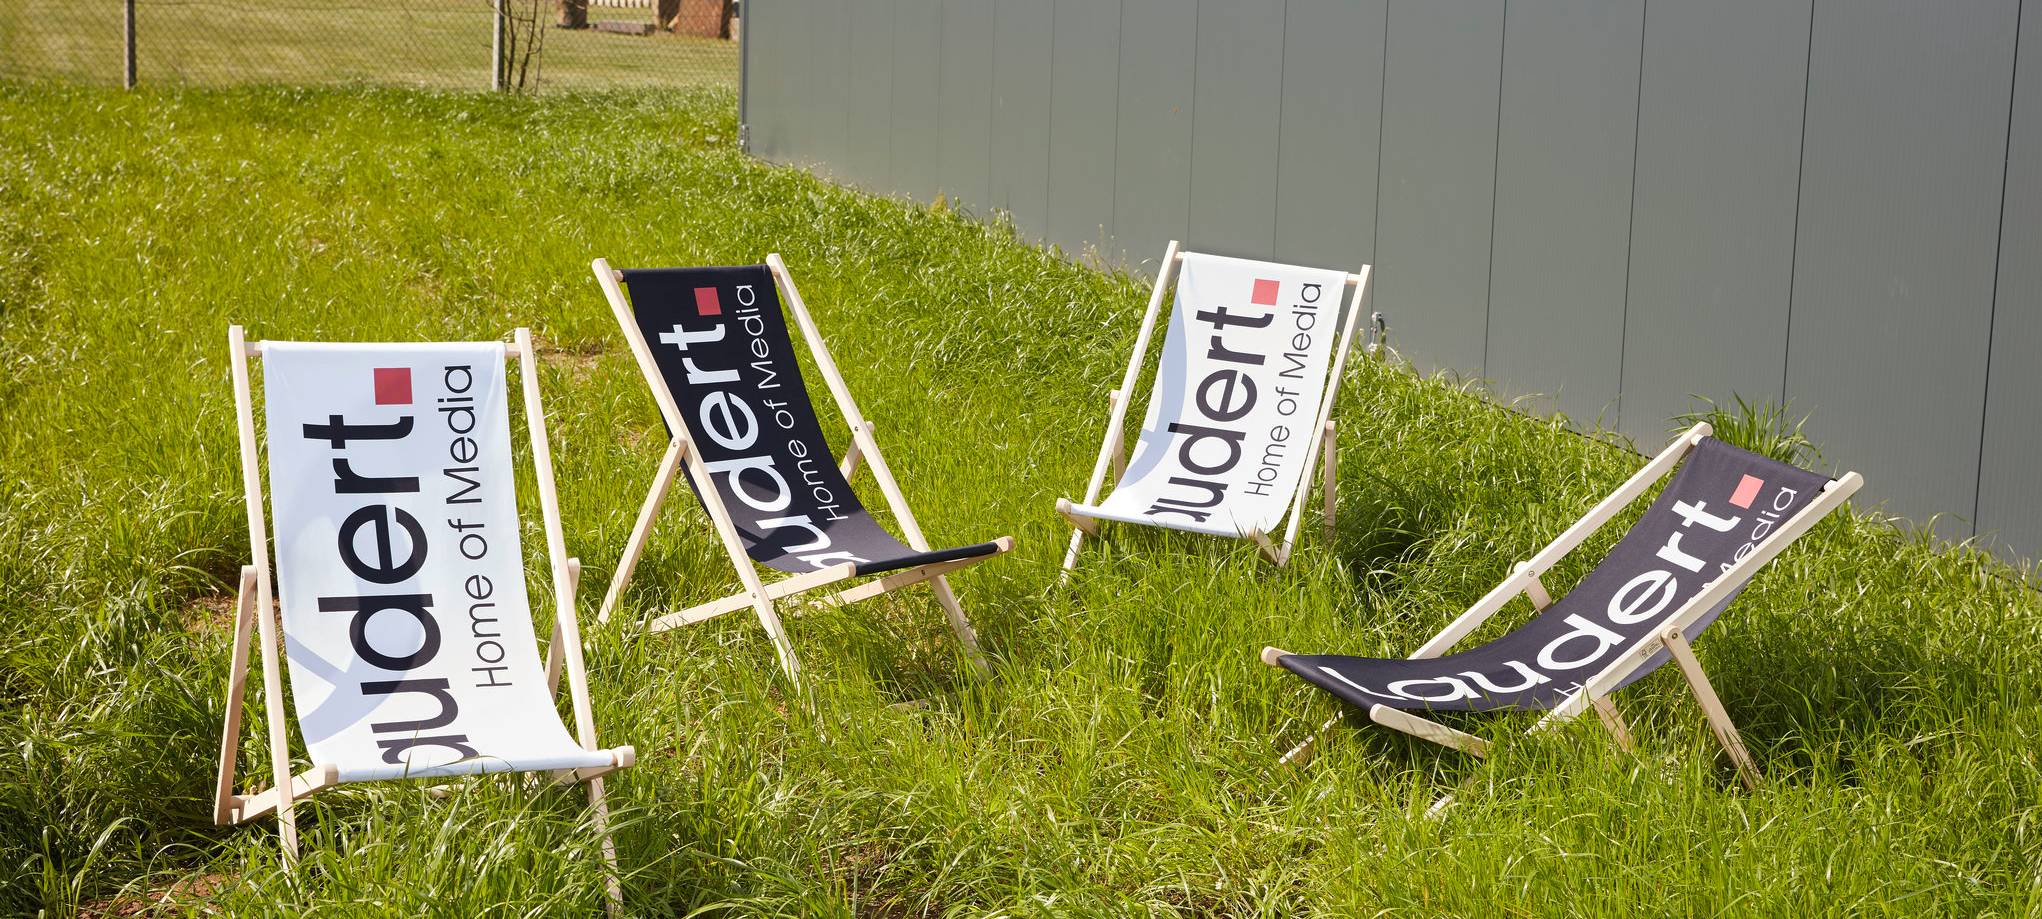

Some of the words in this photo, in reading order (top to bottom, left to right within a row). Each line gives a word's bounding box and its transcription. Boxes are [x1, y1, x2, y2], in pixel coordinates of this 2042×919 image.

[735, 284, 781, 389] Media
[1279, 283, 1322, 379] Media
[437, 365, 482, 505] Media
[763, 399, 794, 429] of
[1275, 386, 1300, 416] of
[788, 439, 848, 521] Home
[1244, 425, 1290, 496] Home
[447, 518, 488, 560] of
[464, 574, 512, 688] Home
